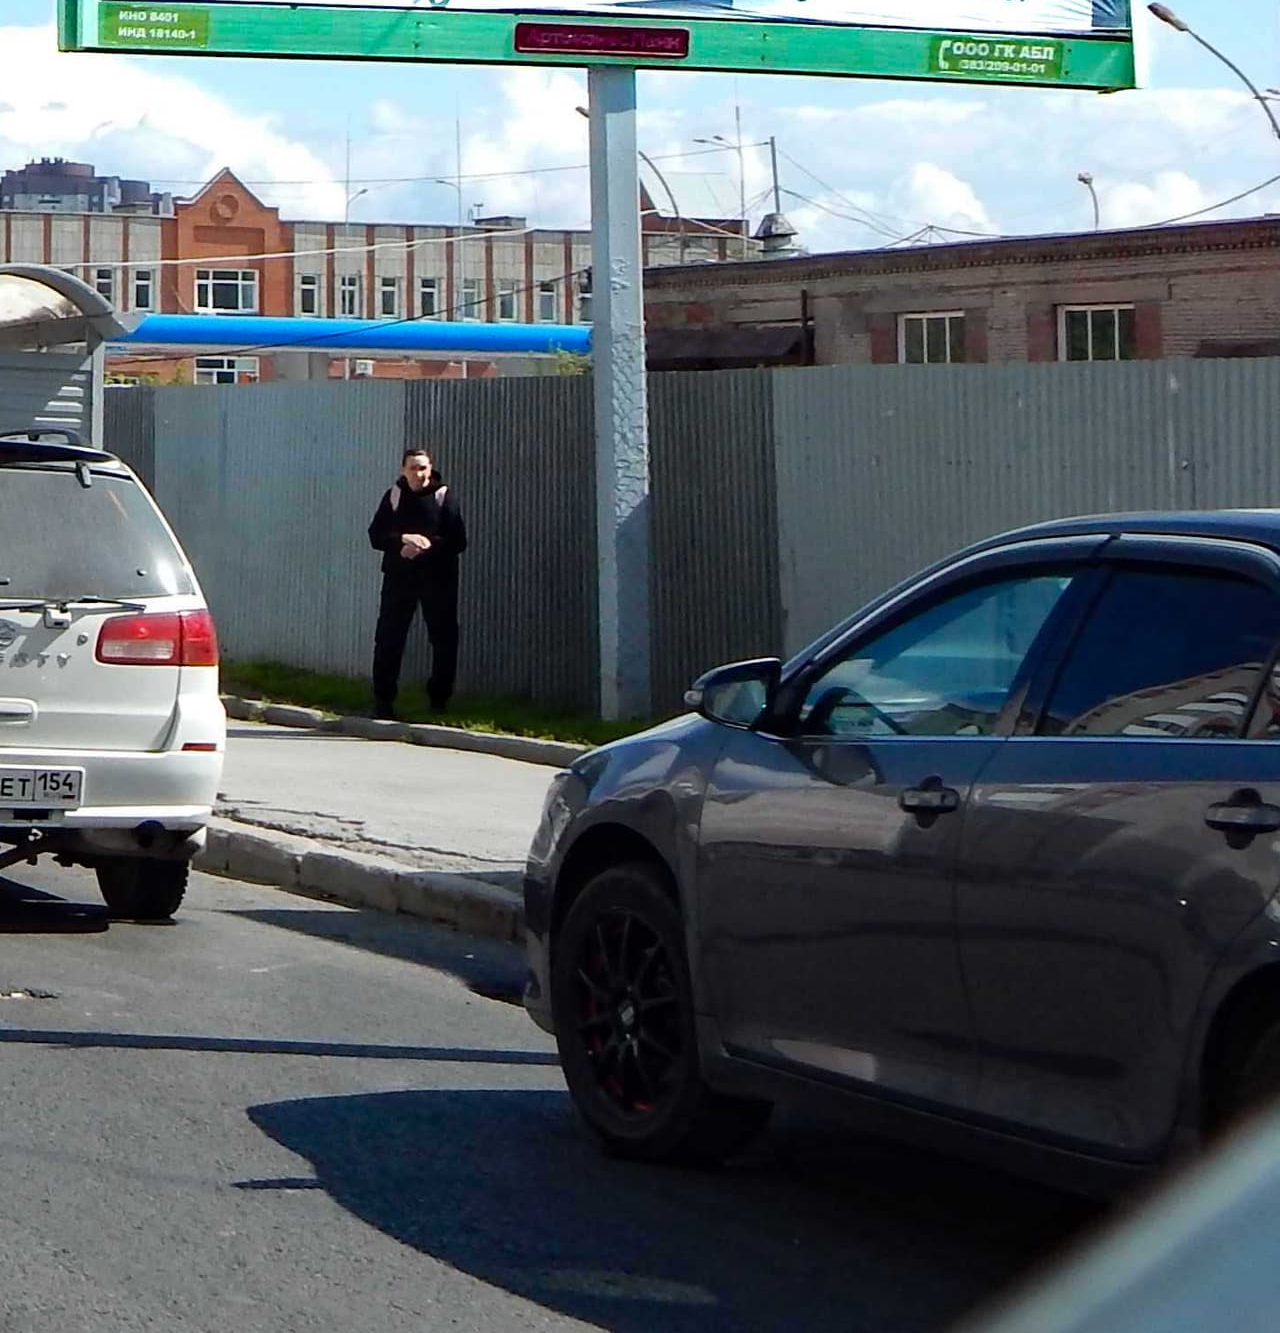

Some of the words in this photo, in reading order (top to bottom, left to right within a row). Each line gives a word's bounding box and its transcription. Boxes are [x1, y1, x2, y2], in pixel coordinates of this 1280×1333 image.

[952, 41, 990, 55] ООО
[993, 44, 1016, 58] ГК
[37, 772, 74, 792] 154
